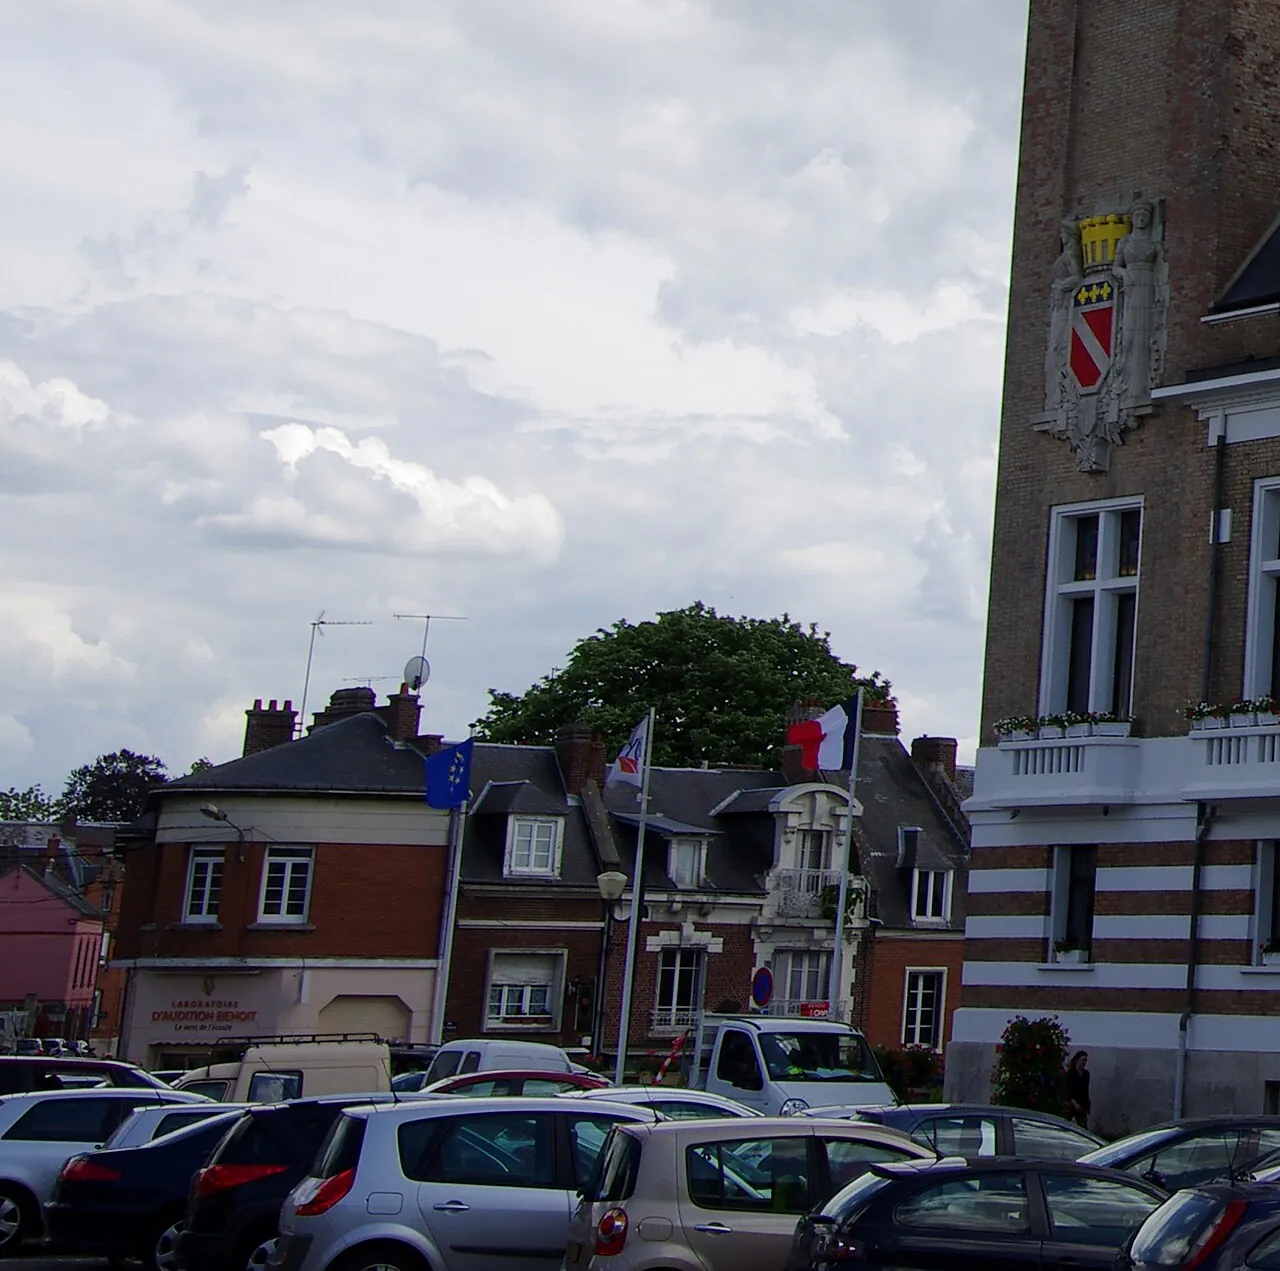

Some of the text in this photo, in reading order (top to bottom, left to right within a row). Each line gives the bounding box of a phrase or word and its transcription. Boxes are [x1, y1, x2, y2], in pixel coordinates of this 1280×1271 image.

[171, 1000, 240, 1009] LABORATOIRE
[152, 1011, 257, 1022] D'AUDITION BENOIT
